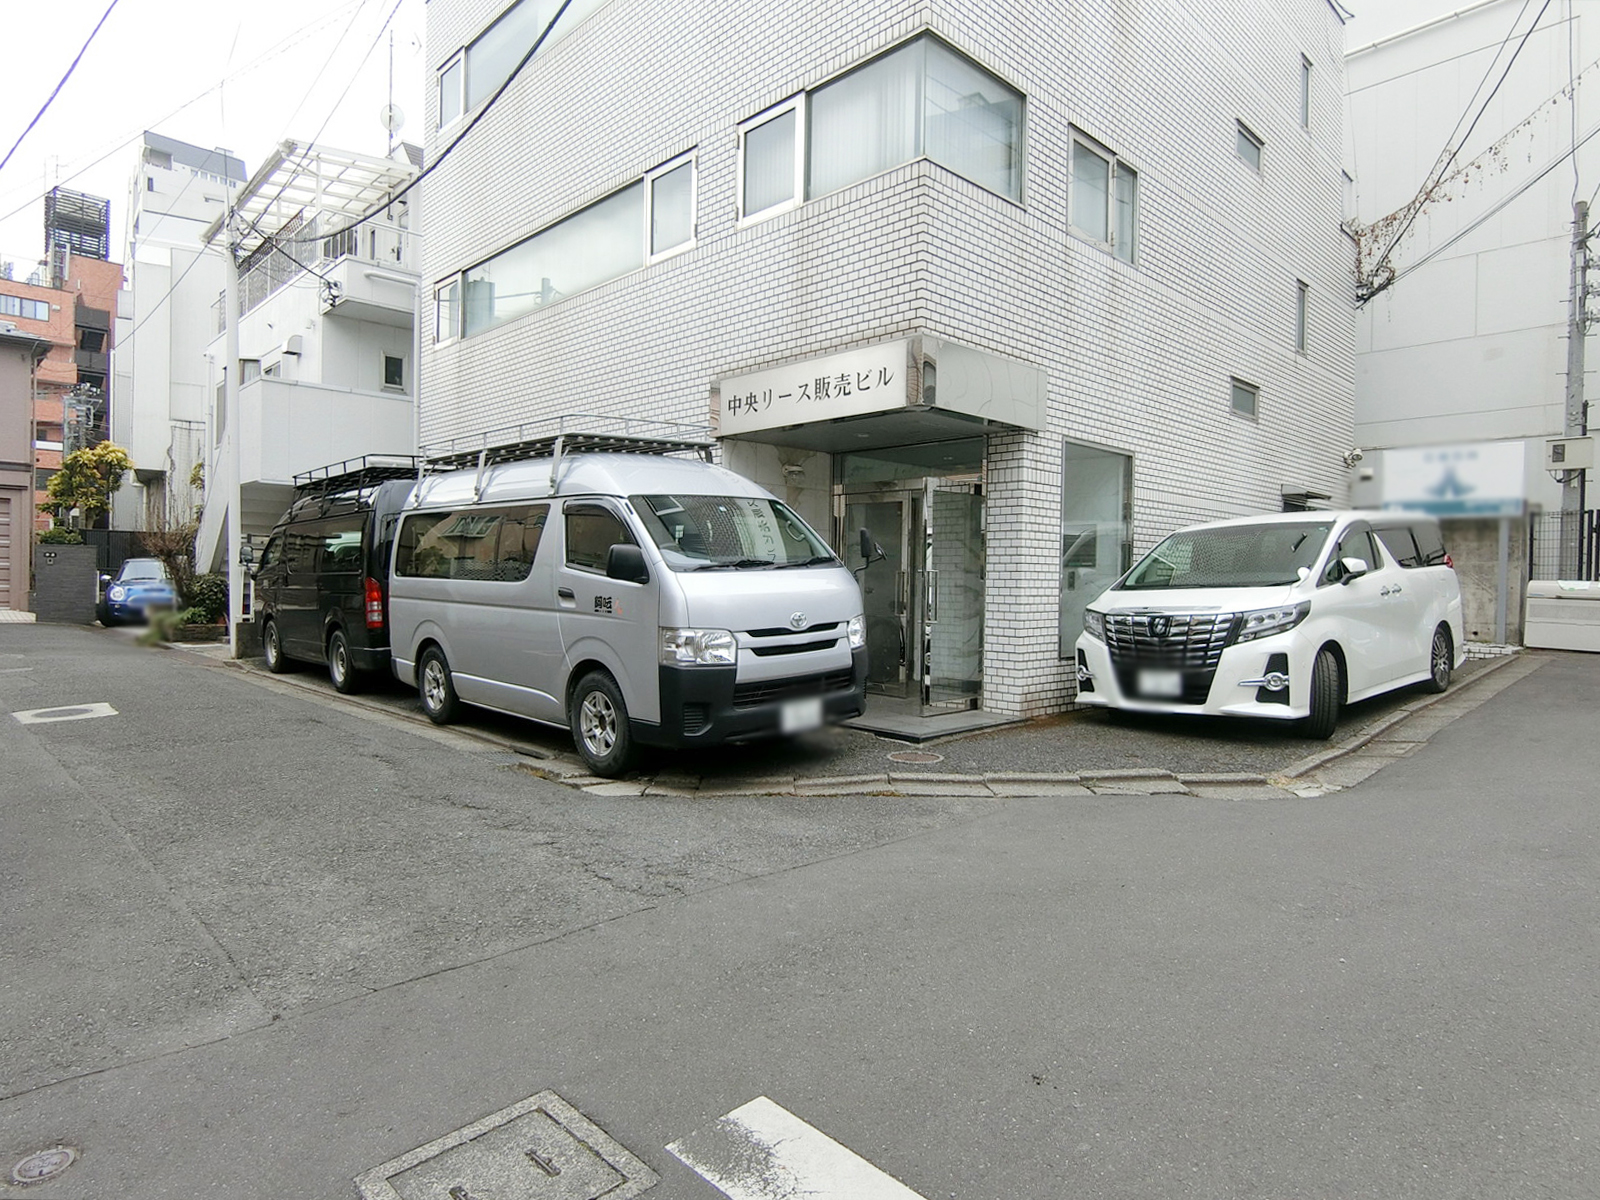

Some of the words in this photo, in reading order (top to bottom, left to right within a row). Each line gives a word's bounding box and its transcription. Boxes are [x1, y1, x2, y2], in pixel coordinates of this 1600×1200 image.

[727, 367, 895, 417] 中央リース販売ビル
